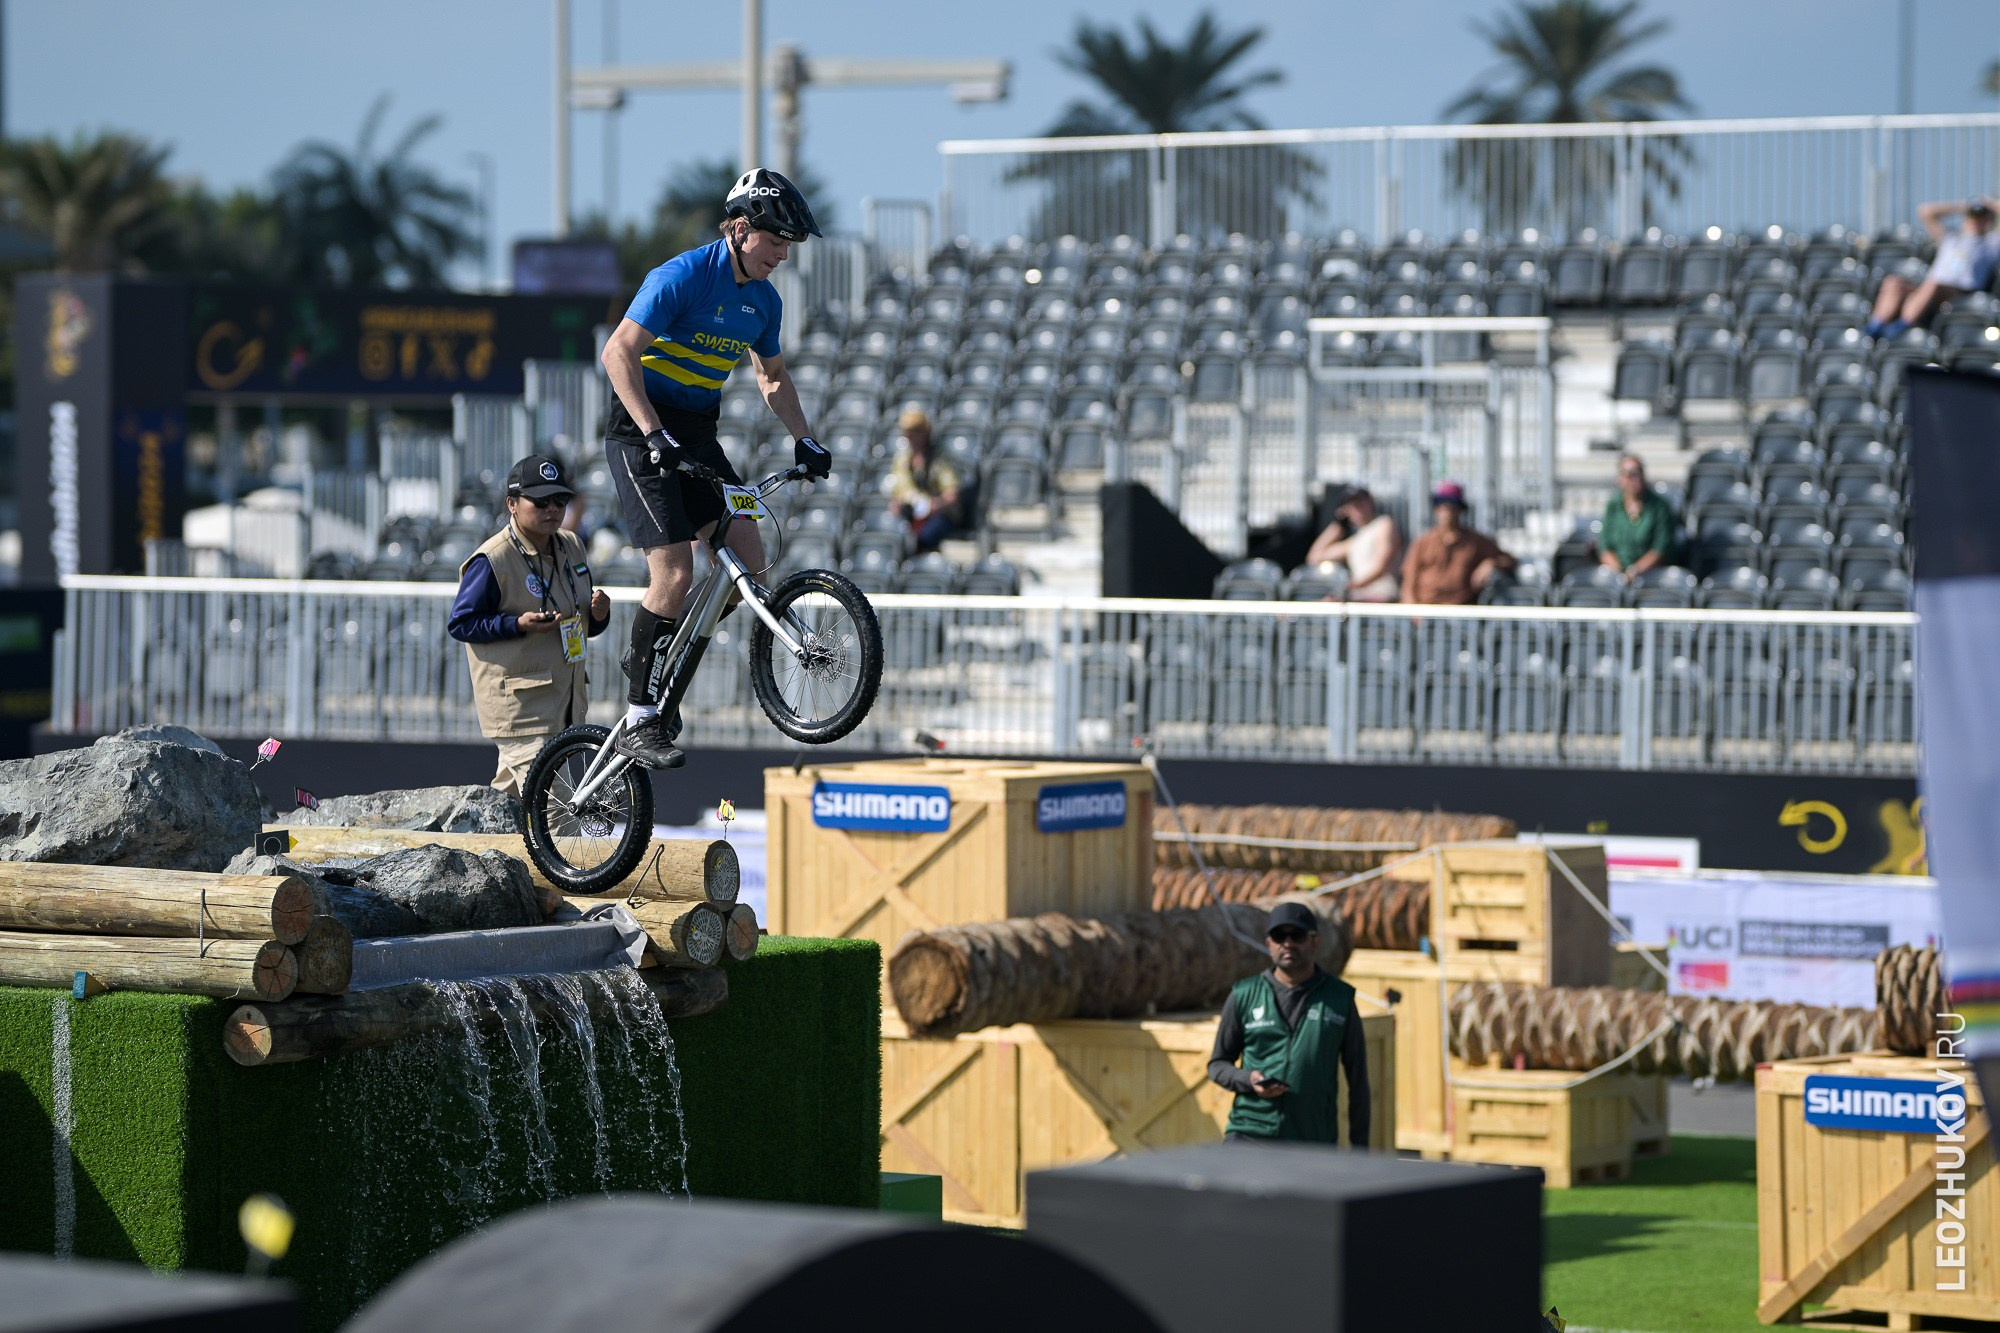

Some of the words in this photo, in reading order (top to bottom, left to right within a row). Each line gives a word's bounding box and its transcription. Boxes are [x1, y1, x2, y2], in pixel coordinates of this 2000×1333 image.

[732, 496, 755, 509] 120
[814, 791, 947, 821] SHIMANO
[1039, 791, 1124, 822] SHIMANO
[1680, 926, 1731, 949] UCI
